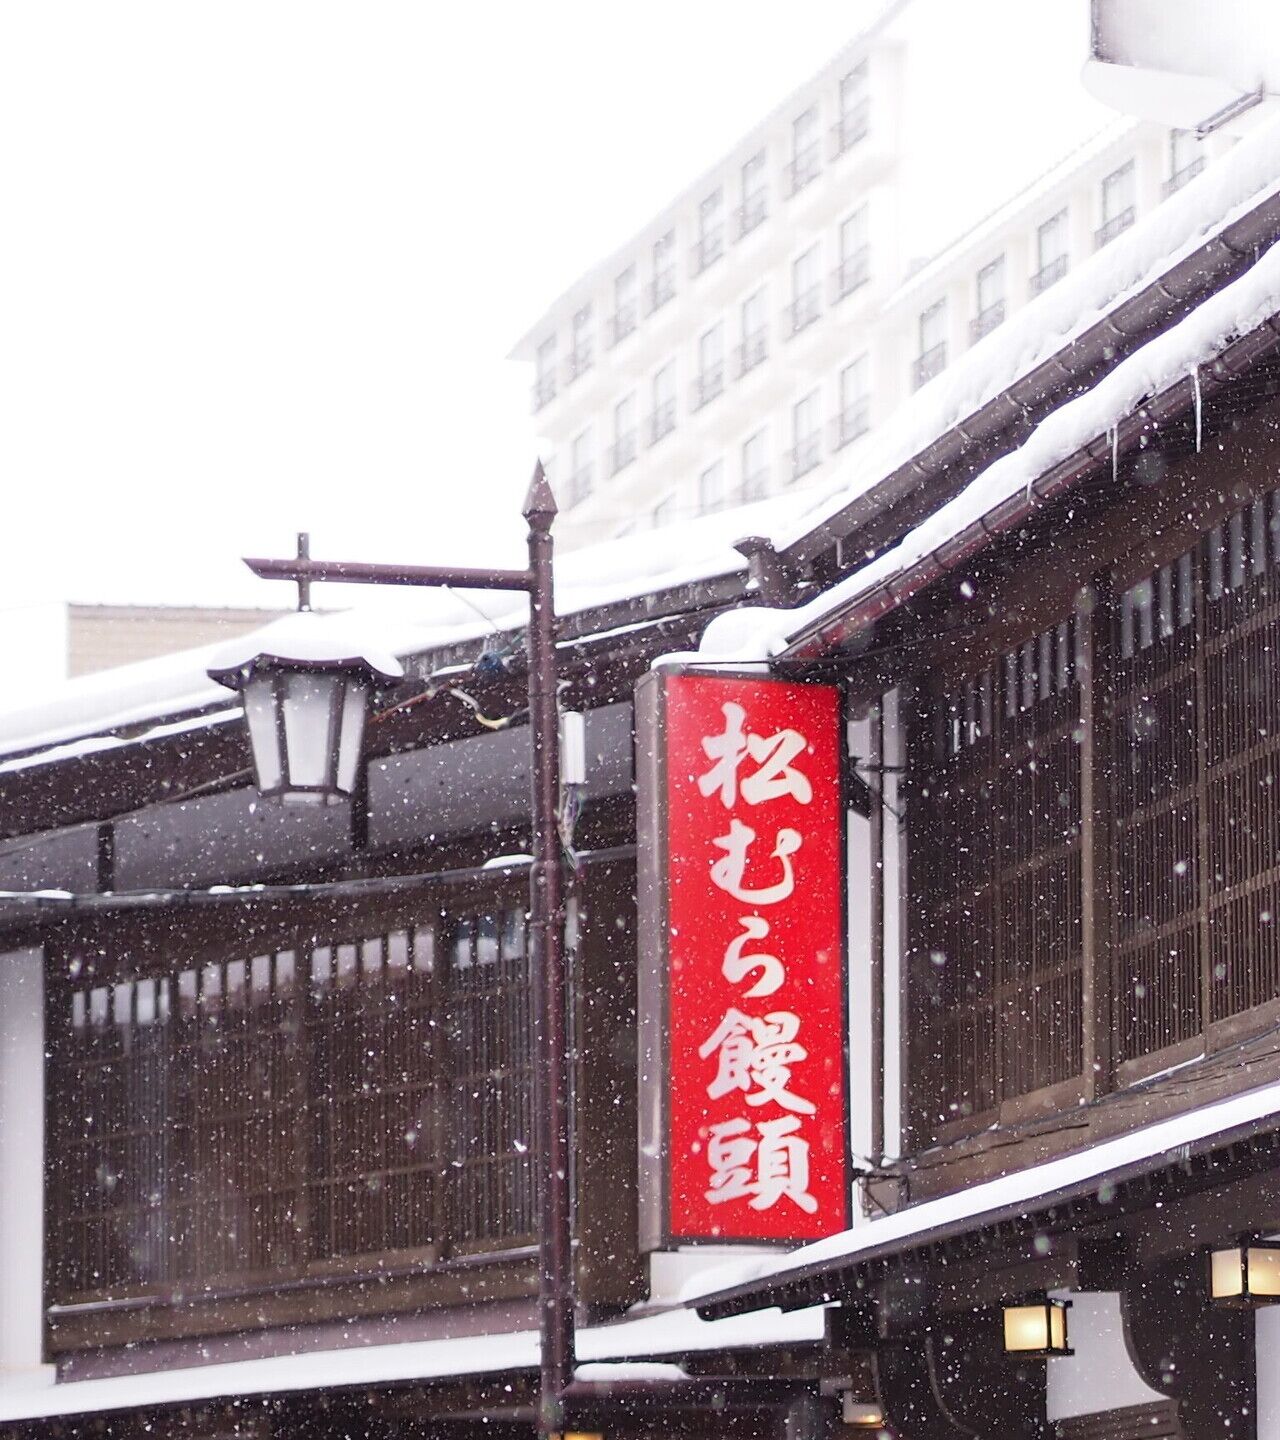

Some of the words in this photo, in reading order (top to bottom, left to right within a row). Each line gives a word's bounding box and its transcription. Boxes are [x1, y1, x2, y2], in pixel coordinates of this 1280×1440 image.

[699, 701, 818, 1214] 松むら饅頭
